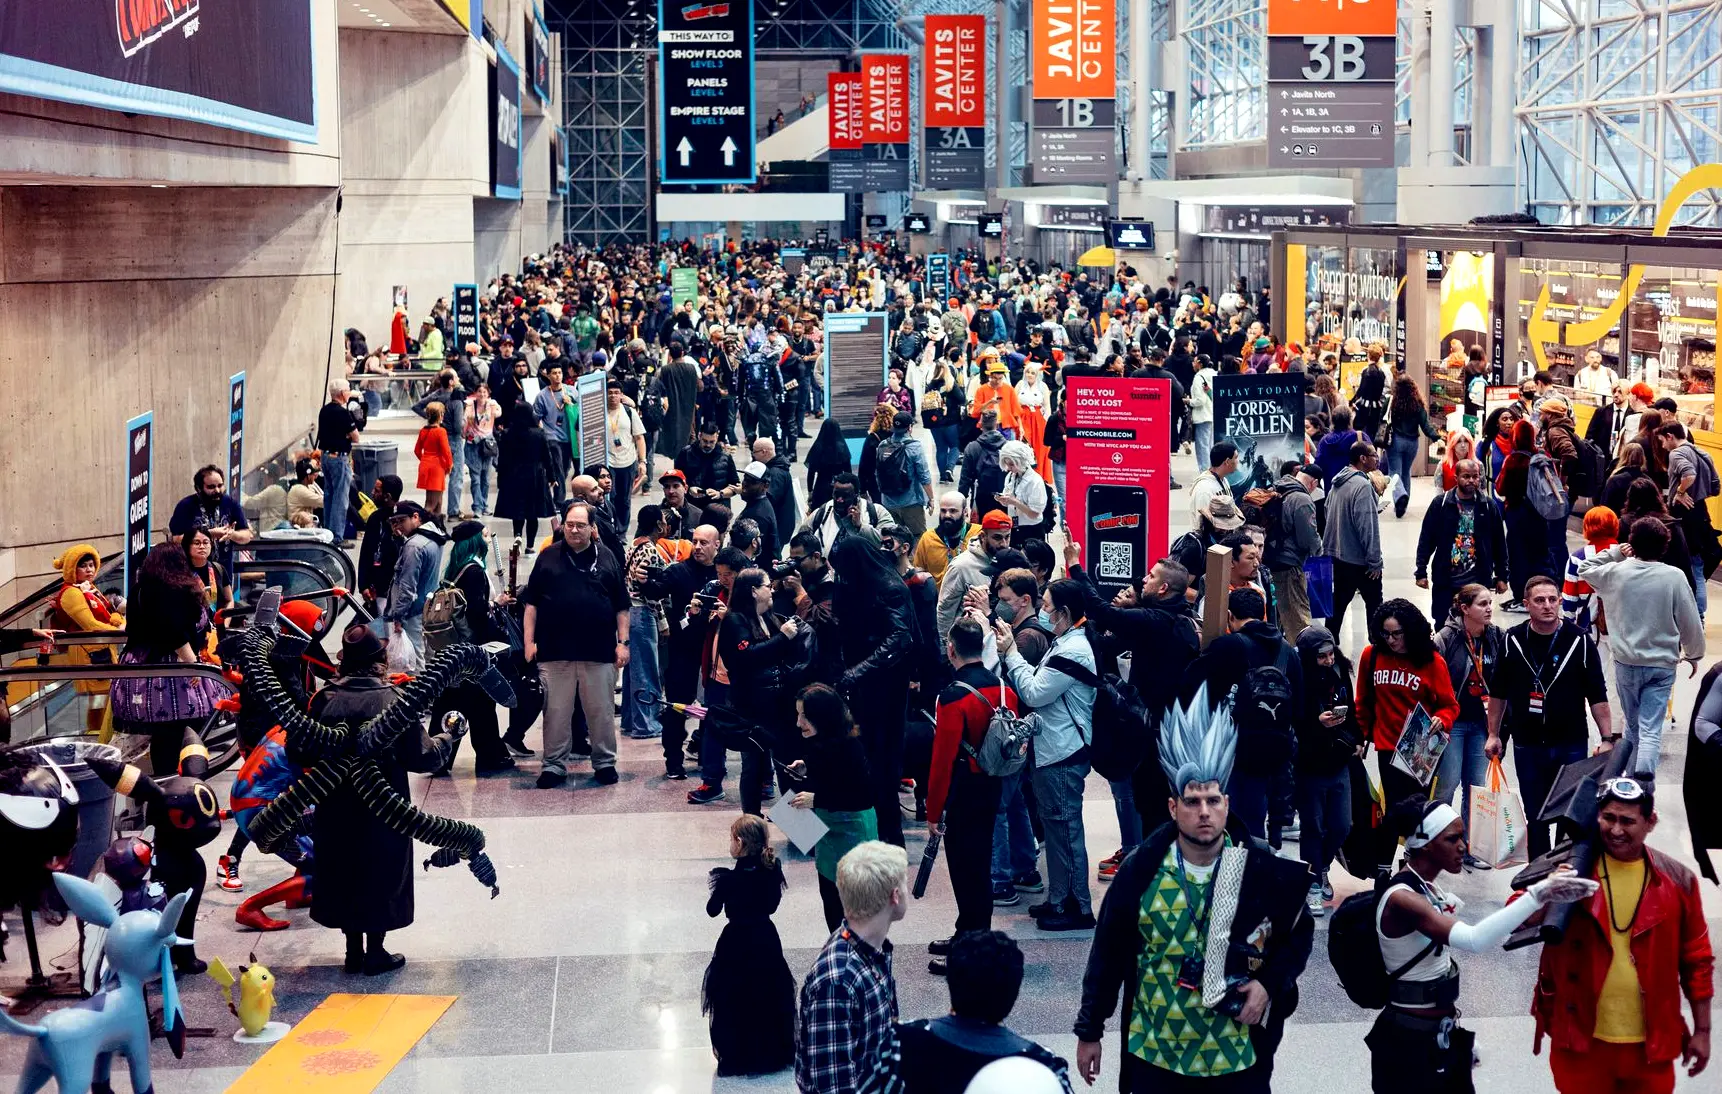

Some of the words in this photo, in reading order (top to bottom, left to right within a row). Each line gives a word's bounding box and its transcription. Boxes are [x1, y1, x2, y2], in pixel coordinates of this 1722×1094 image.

[669, 32, 691, 40] THIS
[693, 32, 714, 40] WAY
[1048, 0, 1073, 77] JAVI
[1082, 1, 1102, 78] CENT
[671, 49, 704, 59] SHOW
[705, 49, 742, 59] FLOOR
[690, 60, 716, 68] LEVEL
[717, 60, 724, 68] 3
[1301, 36, 1366, 80] 3B
[935, 29, 954, 112] JAVITS
[960, 28, 975, 113] CENTER
[687, 78, 728, 87] PANELS
[690, 88, 716, 96] LEVEL
[718, 88, 724, 96] 4
[870, 65, 885, 131] JAVITS
[890, 65, 902, 132] CENTER
[1291, 90, 1313, 99] Javits
[1314, 90, 1336, 99] North
[670, 106, 710, 116] EMPIRE
[711, 106, 745, 116] STAGE
[691, 117, 717, 125] LEVEL
[718, 117, 724, 125] 5
[834, 82, 848, 139] JAVITS
[852, 82, 863, 139] CENTER
[1056, 99, 1094, 128] 1B
[1292, 108, 1304, 117] 1A,
[1305, 108, 1317, 117] 1B,
[1318, 108, 1329, 116] 3A
[939, 127, 972, 149] 3A
[1291, 125, 1321, 133] Elevator
[1322, 125, 1330, 133] to
[1331, 125, 1343, 134] 1C,
[1344, 125, 1356, 133] 3B
[874, 143, 898, 160] 1A
[1311, 259, 1358, 304] Shopping
[1360, 264, 1398, 301] withou
[1660, 296, 1680, 317] Just
[458, 314, 475, 323] SHOW
[1323, 304, 1340, 336] the
[458, 326, 476, 336] FLOOR
[1657, 320, 1682, 344] Walk
[1660, 346, 1679, 371] Out
[1076, 388, 1095, 397] HEY,
[1097, 389, 1115, 397] YOU
[1220, 387, 1250, 397] PLAY
[1257, 385, 1298, 395] TODAY
[1076, 398, 1099, 406] LOOK
[1101, 399, 1122, 407] LOST
[1231, 401, 1276, 416] LORDS
[1076, 430, 1133, 438] NYCCMOBILE.COM
[1225, 414, 1293, 436] FALLEN
[130, 473, 142, 493] DOWN
[142, 470, 149, 485] TO
[130, 495, 148, 524] QUEUE
[132, 528, 146, 555] HALL
[1373, 669, 1389, 686] FOR
[1390, 670, 1421, 691] DAYS
